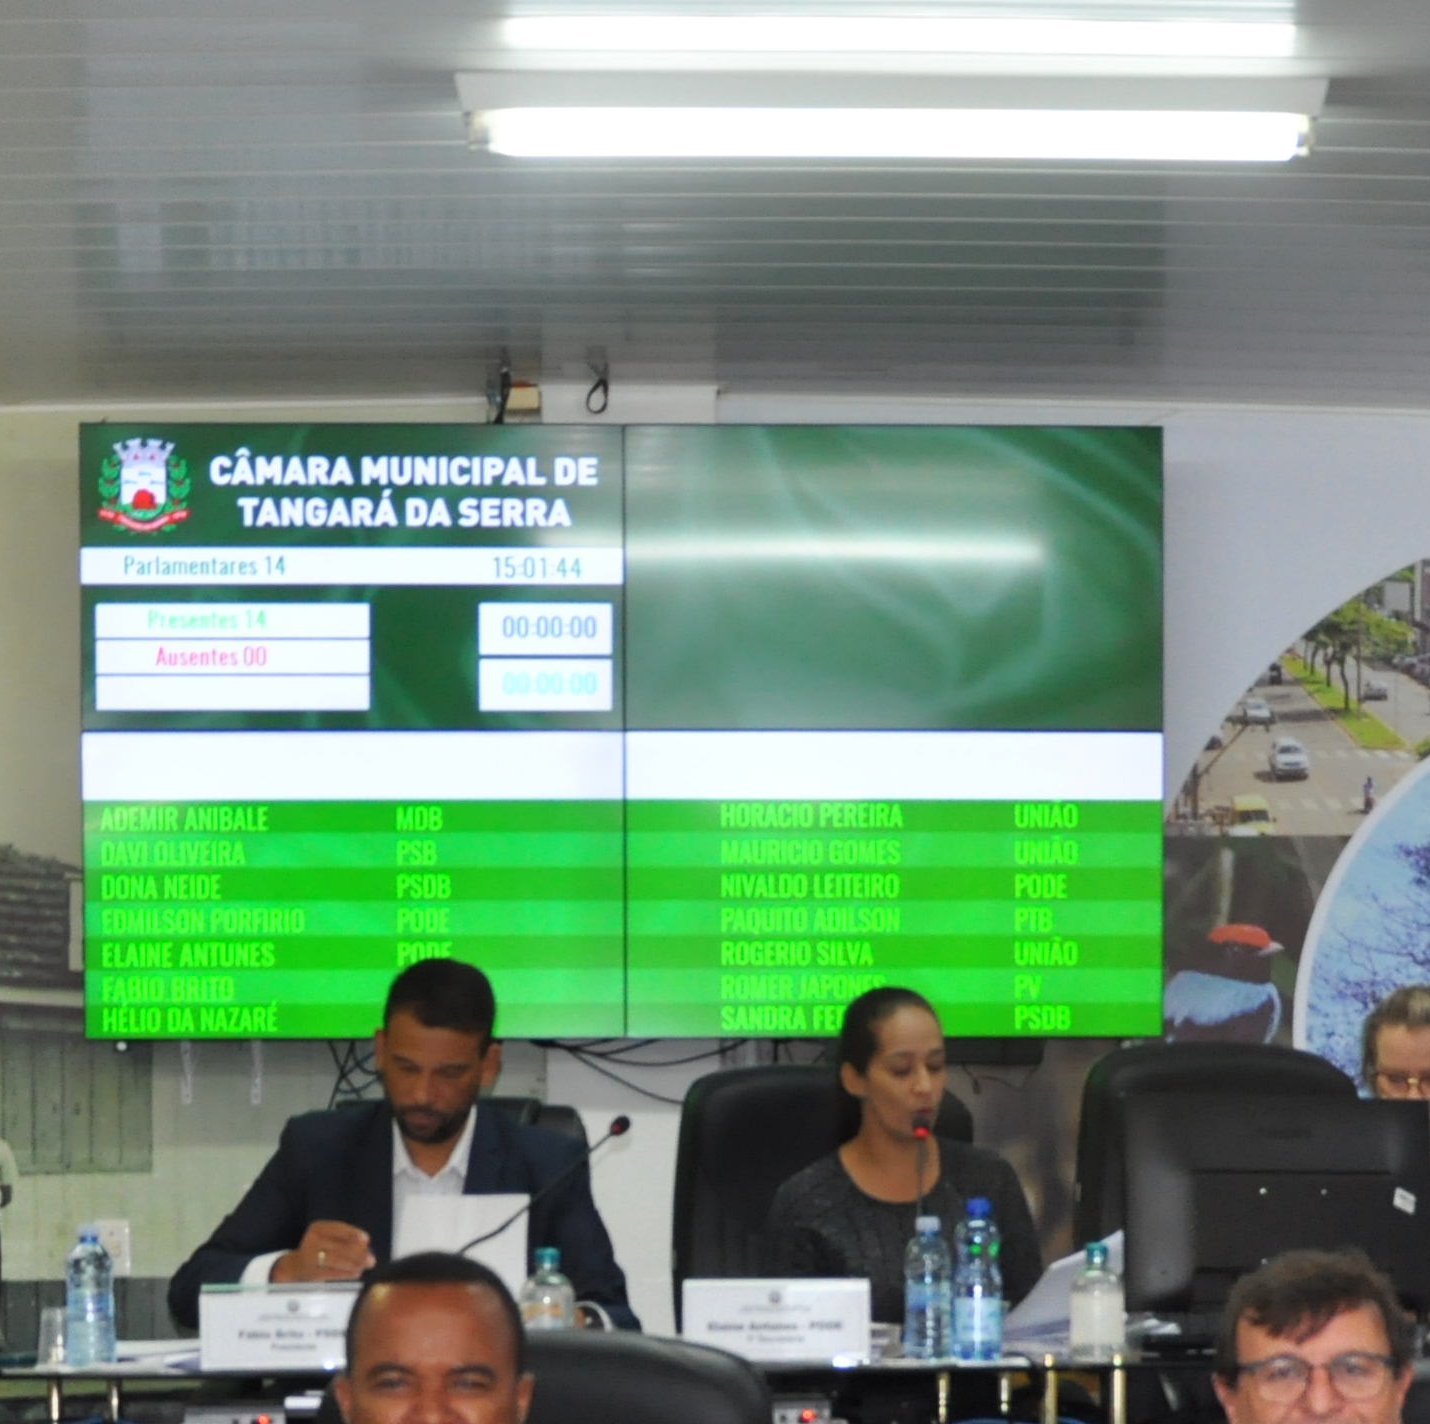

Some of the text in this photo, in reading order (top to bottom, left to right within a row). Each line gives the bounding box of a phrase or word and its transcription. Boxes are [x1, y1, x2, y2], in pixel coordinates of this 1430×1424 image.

[209, 447, 599, 487] CÂMARA MUNICIPAL DE
[237, 489, 572, 528] TANGARÁ DA SERRA
[123, 555, 286, 576] Parlamentares 14
[492, 557, 582, 579] 15:01:44
[148, 609, 267, 630] Presentes 14
[502, 616, 597, 639] 00:00:00
[156, 647, 267, 667] Ausentes 00
[502, 672, 597, 695] 00:00:00
[100, 806, 269, 831] ADEMIR ANIBALE
[395, 806, 443, 831] MDB
[720, 802, 904, 828] HORACIO PEREIRA
[101, 840, 246, 866] DAVI OLIVEIRA
[396, 840, 436, 865] PSB
[720, 839, 901, 865] MAURICIO GOMES
[1014, 834, 1079, 865] UNIÃO
[101, 874, 221, 900] DONA NEIDE
[396, 874, 451, 899] PSDB
[720, 873, 900, 899] NIVALDO LEITEIRO
[1014, 873, 1069, 899] PODE
[101, 908, 306, 934] EDMILSON PORFIRIO
[396, 907, 451, 933] PODE
[720, 907, 900, 935] PAQUITO ADILSON
[1014, 907, 1054, 932] PTB
[102, 942, 276, 968] ELAINE ANTUNES
[721, 941, 874, 966] ROGERIO SILVA
[1014, 936, 1079, 966] UNIÃO
[102, 975, 235, 1001] FABIO BRITO
[721, 975, 793, 1000] ROMER
[1014, 973, 1042, 999] PV
[102, 998, 278, 1032] HÉLIO DA NAZARÉ
[721, 1005, 807, 1031] SANDRA
[1014, 1005, 1072, 1031] PSDB
